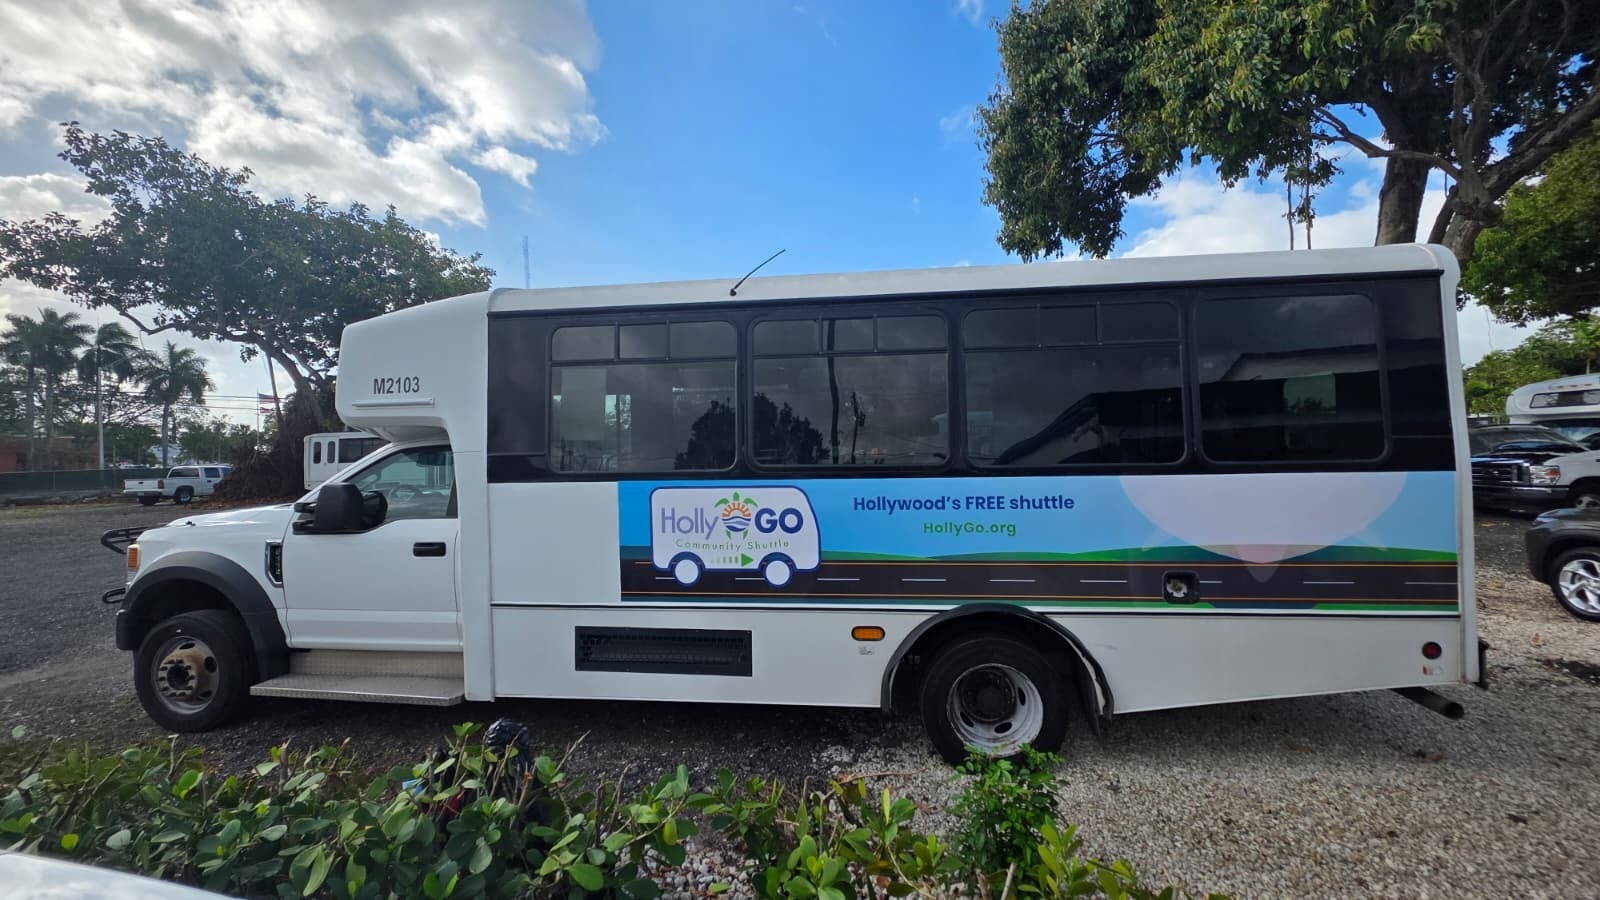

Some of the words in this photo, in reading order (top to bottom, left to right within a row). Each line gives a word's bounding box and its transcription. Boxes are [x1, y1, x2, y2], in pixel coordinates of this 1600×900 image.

[373, 376, 420, 395] M2103
[853, 495, 961, 515] Hollywood's
[965, 495, 1005, 510] FREE
[1009, 494, 1075, 510] shuttle
[661, 507, 719, 540] Holly
[754, 507, 804, 534] GO
[923, 521, 1017, 537] HollyGo.org
[675, 538, 741, 552] Community
[747, 538, 790, 550] Shuttle
